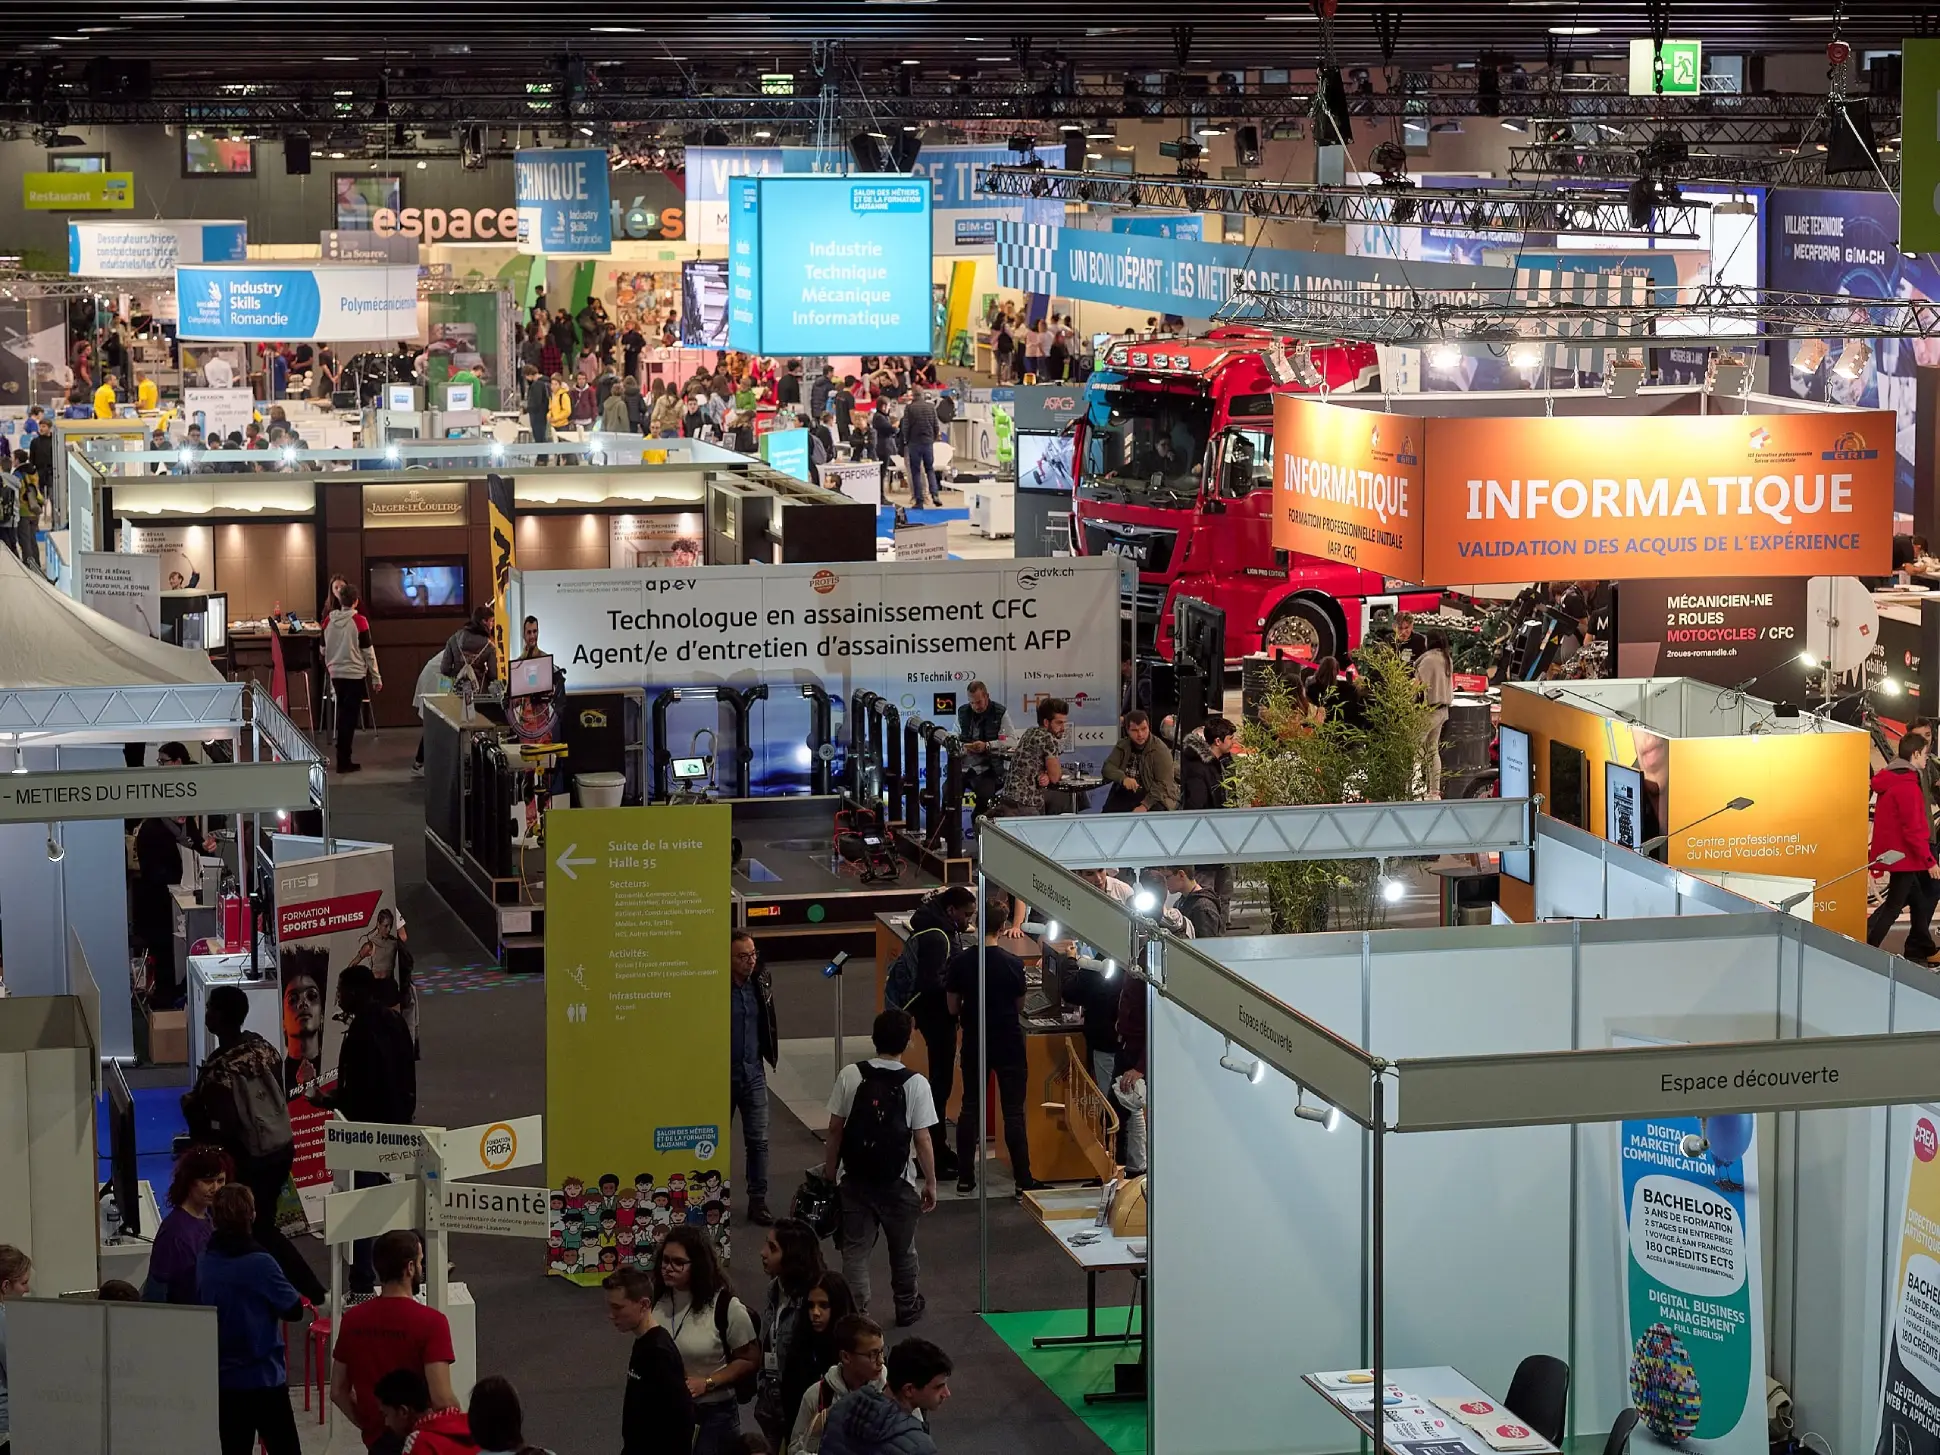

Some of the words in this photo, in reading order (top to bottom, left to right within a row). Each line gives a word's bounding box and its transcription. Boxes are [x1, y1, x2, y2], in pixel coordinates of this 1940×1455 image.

[29, 191, 91, 202] Restaurant
[854, 188, 875, 196] SALON
[877, 188, 890, 196] DES
[891, 187, 920, 197] MÉTIERS
[888, 196, 922, 204] FORMATION
[569, 210, 599, 223] Industry
[570, 222, 588, 233] Skills
[1784, 215, 1810, 235] VILLAGE
[1810, 216, 1844, 237] TECHNIQUE
[570, 234, 603, 245] Romandie
[809, 241, 883, 257] Industrie
[1793, 243, 1840, 263] MECAFORMA
[804, 264, 888, 283] Technique
[1069, 249, 1088, 283] UN
[1090, 252, 1114, 287] BON
[1117, 247, 1163, 294] DÉPART
[1171, 261, 1195, 298] LES
[229, 281, 283, 298] Industry
[801, 287, 891, 306] Mécanique
[230, 296, 261, 310] Skills
[230, 312, 289, 326] Romandie
[793, 310, 900, 329] Informatique
[1283, 453, 1409, 524] INFORMATIQUE
[1466, 473, 1853, 525] INFORMATIQUE
[1288, 508, 1321, 529] FORMATION
[1322, 516, 1376, 543] PROFESSIONNELLE
[1376, 529, 1403, 551] INITIALE
[1107, 542, 1148, 560] MAN
[1327, 540, 1342, 558] (AFP,
[1343, 545, 1357, 562] CFC)
[1458, 538, 1577, 558] VALIDATION
[1583, 537, 1619, 555] DES
[1624, 536, 1698, 556] ACQUIS
[1703, 535, 1728, 552] DE
[1733, 530, 1861, 551] L'EXPÉRIENCE
[1034, 567, 1074, 578] advk.ch
[1268, 570, 1286, 578] EDITION
[645, 578, 697, 594] apev
[1666, 592, 1773, 610] MÉCANICIEN-NE
[607, 608, 758, 632] Technologue
[767, 609, 795, 626] en
[805, 600, 984, 624] assainissement
[992, 598, 1037, 620] CFC
[1666, 613, 1675, 625] 2
[1678, 611, 1724, 625] ROUES
[1666, 628, 1757, 643] MOTOCYCLES
[1760, 628, 1766, 640] /
[1768, 626, 1795, 639] CFC
[572, 640, 668, 670] Agent/e
[676, 636, 808, 662] d'entretien
[816, 631, 1017, 657] d'assainissement
[1025, 628, 1071, 651] AFP
[1666, 647, 1738, 659] 2roues-romandie.ch
[907, 673, 918, 683] RS
[920, 670, 953, 683] Technik
[16, 786, 92, 805] METIERS
[96, 784, 121, 802] DU
[126, 782, 198, 800] FITNESS
[608, 840, 639, 852] Suite
[641, 839, 656, 851] de
[659, 839, 669, 850] la
[672, 838, 704, 850] visite
[1687, 836, 1724, 849] Centre
[1728, 832, 1801, 848] professionnel
[1687, 847, 1701, 859] du
[1704, 847, 1732, 859] Nord
[1735, 846, 1782, 860] Vaudois,
[1785, 844, 1818, 856] CPNV
[608, 856, 639, 868] Halle
[642, 858, 657, 870] 35
[609, 880, 650, 889] Secteurs:
[1032, 873, 1049, 898] Espace
[1048, 880, 1072, 912] découverte
[283, 906, 330, 922] FORMATION
[1813, 900, 1837, 912] PSIC
[282, 919, 318, 934] SPORTS
[319, 917, 327, 927] &
[328, 911, 364, 926] FITNESS
[609, 948, 649, 958] Activités:
[609, 990, 672, 1001] Infrastructure:
[1238, 1004, 1260, 1034] Espace
[1259, 1019, 1293, 1054] découverte
[1661, 1070, 1728, 1095] Espace
[1733, 1065, 1840, 1090] découverte
[328, 1128, 374, 1145] Brigade
[682, 1133, 716, 1142] FORMATION
[690, 1127, 714, 1136] MÉTIERS
[1913, 1124, 1935, 1150] CREA
[486, 1136, 511, 1145] FONDATION
[657, 1141, 688, 1149] LAUSANNE
[699, 1143, 711, 1154] 10
[486, 1143, 512, 1156] PROFA
[1623, 1147, 1716, 1177] COMMUNICATION
[1643, 1188, 1733, 1222] BACHELORS
[440, 1213, 457, 1221] Centre
[1644, 1206, 1650, 1215] 3
[1651, 1208, 1669, 1220] ANS
[1669, 1212, 1682, 1223] DE
[1683, 1215, 1733, 1235] FORMATION
[1644, 1218, 1650, 1226] 2
[1650, 1220, 1677, 1233] STAGES
[1678, 1226, 1689, 1236] EN
[1690, 1229, 1733, 1246] ENTREPRISE
[1645, 1240, 1663, 1253] 180
[1664, 1243, 1708, 1264] CRÉDITS
[1710, 1254, 1735, 1271] ECTS
[1648, 1288, 1690, 1310] DIGITAL
[1693, 1300, 1745, 1324] BUSINESS
[1660, 1305, 1736, 1335] MANAGEMENT
[1674, 1323, 1692, 1336] FULL
[1692, 1327, 1724, 1342] ENGLISH
[1886, 1390, 1901, 1412] WEB
[1901, 1402, 1908, 1417] &
[1908, 1407, 1940, 1440] APPLICAT
